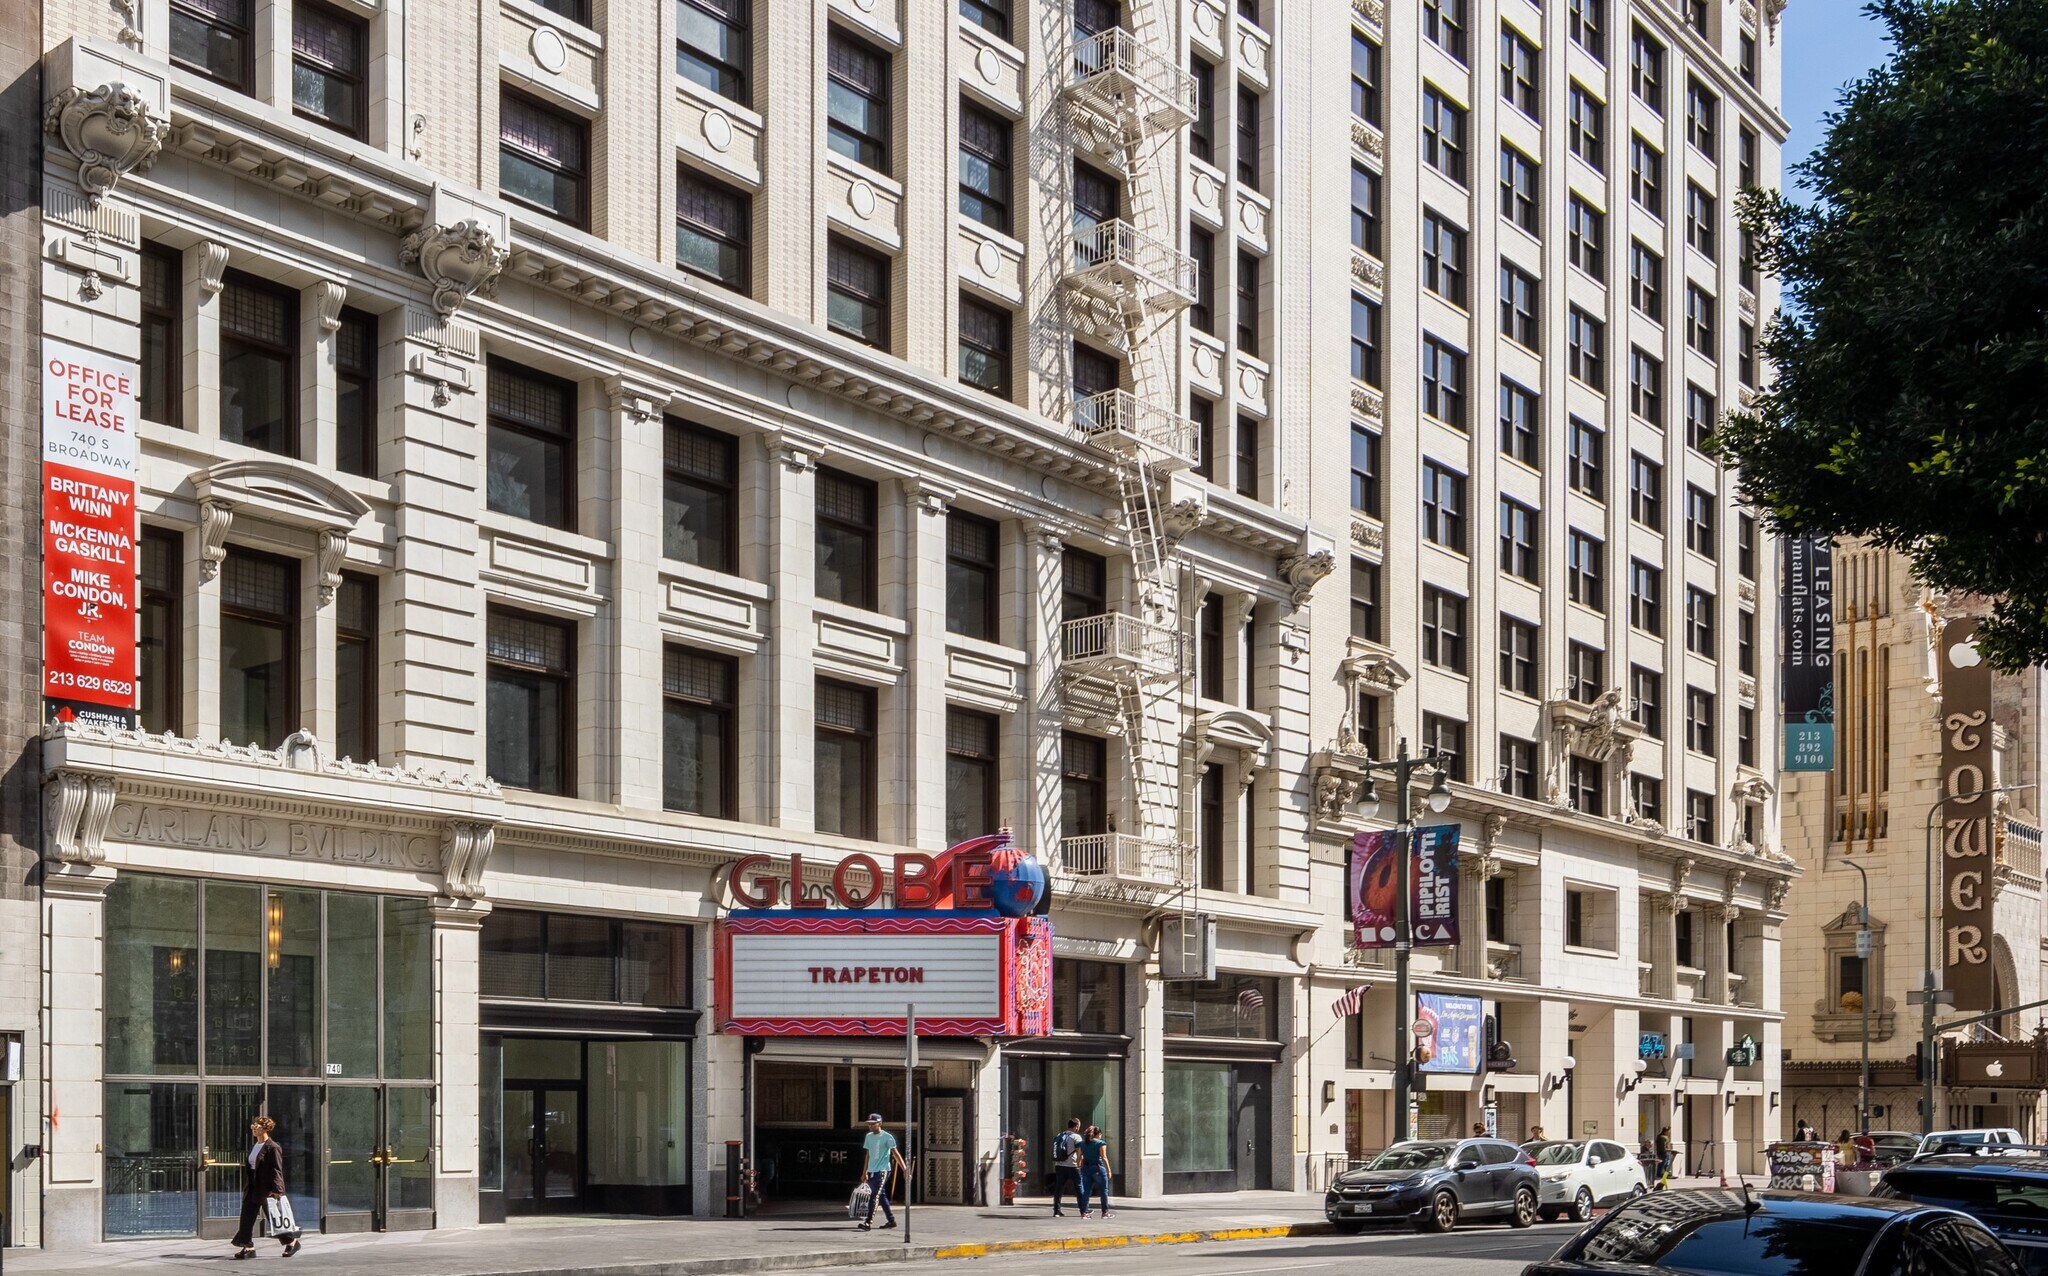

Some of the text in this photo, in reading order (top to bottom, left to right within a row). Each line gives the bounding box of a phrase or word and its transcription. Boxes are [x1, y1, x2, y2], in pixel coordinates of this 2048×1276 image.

[48, 359, 130, 395] OFFICE
[68, 384, 113, 410] FOR
[55, 400, 125, 433] LEASE
[71, 431, 109, 450] 740 S
[49, 442, 131, 470] BROADWAY
[50, 476, 130, 506] BRITTANY
[69, 496, 112, 518] WINN
[50, 520, 131, 550] MCKENNA
[55, 538, 125, 564] GASKILL
[70, 568, 111, 589] MIKE
[52, 581, 128, 610] CONDON,
[77, 602, 103, 618] JR.
[1815, 567, 1830, 667] LEASING
[68, 640, 115, 655] CONDON
[78, 631, 105, 644] TEAM
[49, 671, 132, 696] 213 629 6529
[79, 710, 127, 724] CUSHMAN &
[1798, 731, 1821, 741] 213
[1798, 743, 1821, 752] 892
[1794, 755, 1824, 764] 9100
[110, 802, 269, 852] GARLAND
[1945, 709, 1988, 967] TOWER
[729, 852, 995, 909] GLOBE
[807, 967, 924, 984] TRAPETON
[327, 1064, 341, 1074] 740
